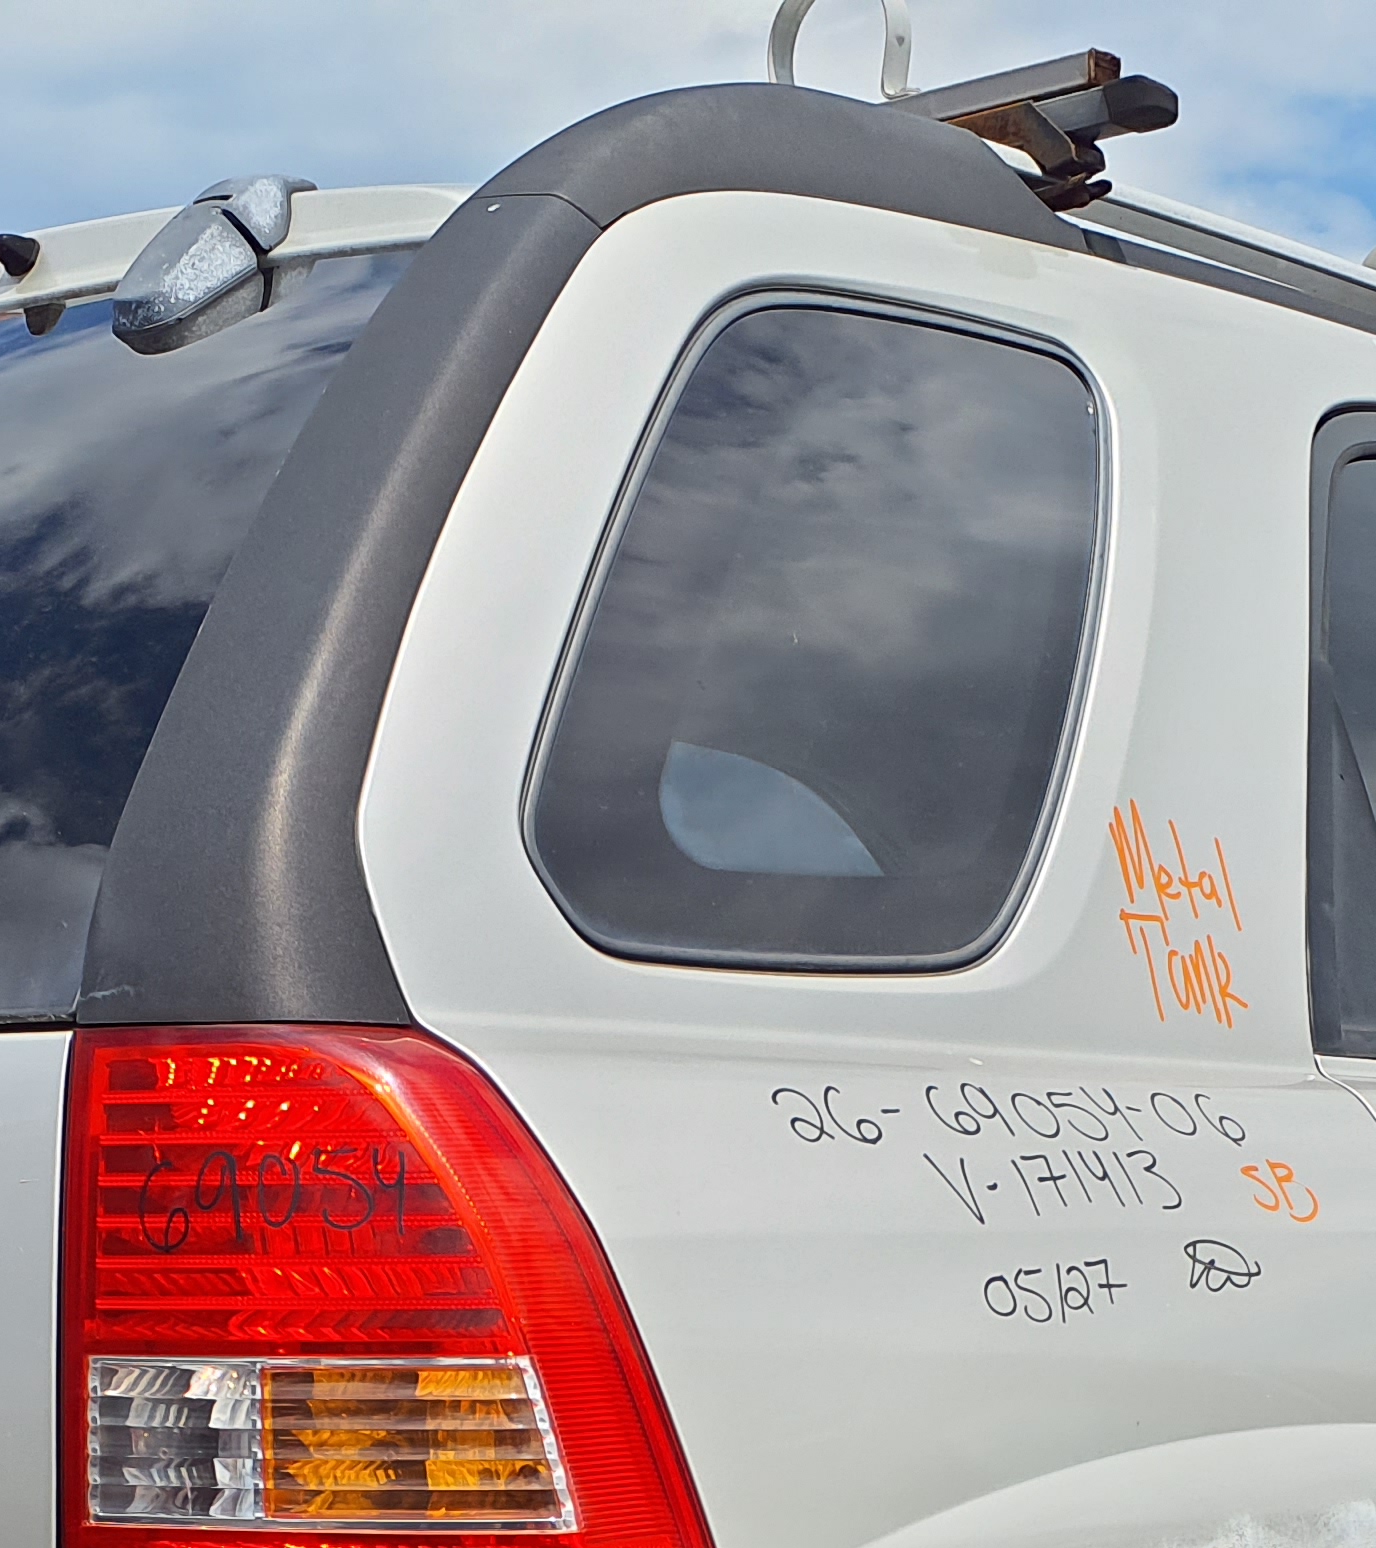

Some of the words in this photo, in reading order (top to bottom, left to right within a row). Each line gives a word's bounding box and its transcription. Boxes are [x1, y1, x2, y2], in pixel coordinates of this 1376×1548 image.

[1109, 797, 1243, 932] Metal
[139, 1146, 407, 1252] 69054
[1240, 1159, 1319, 1222] SB
[982, 1258, 1129, 1324] 05/27
